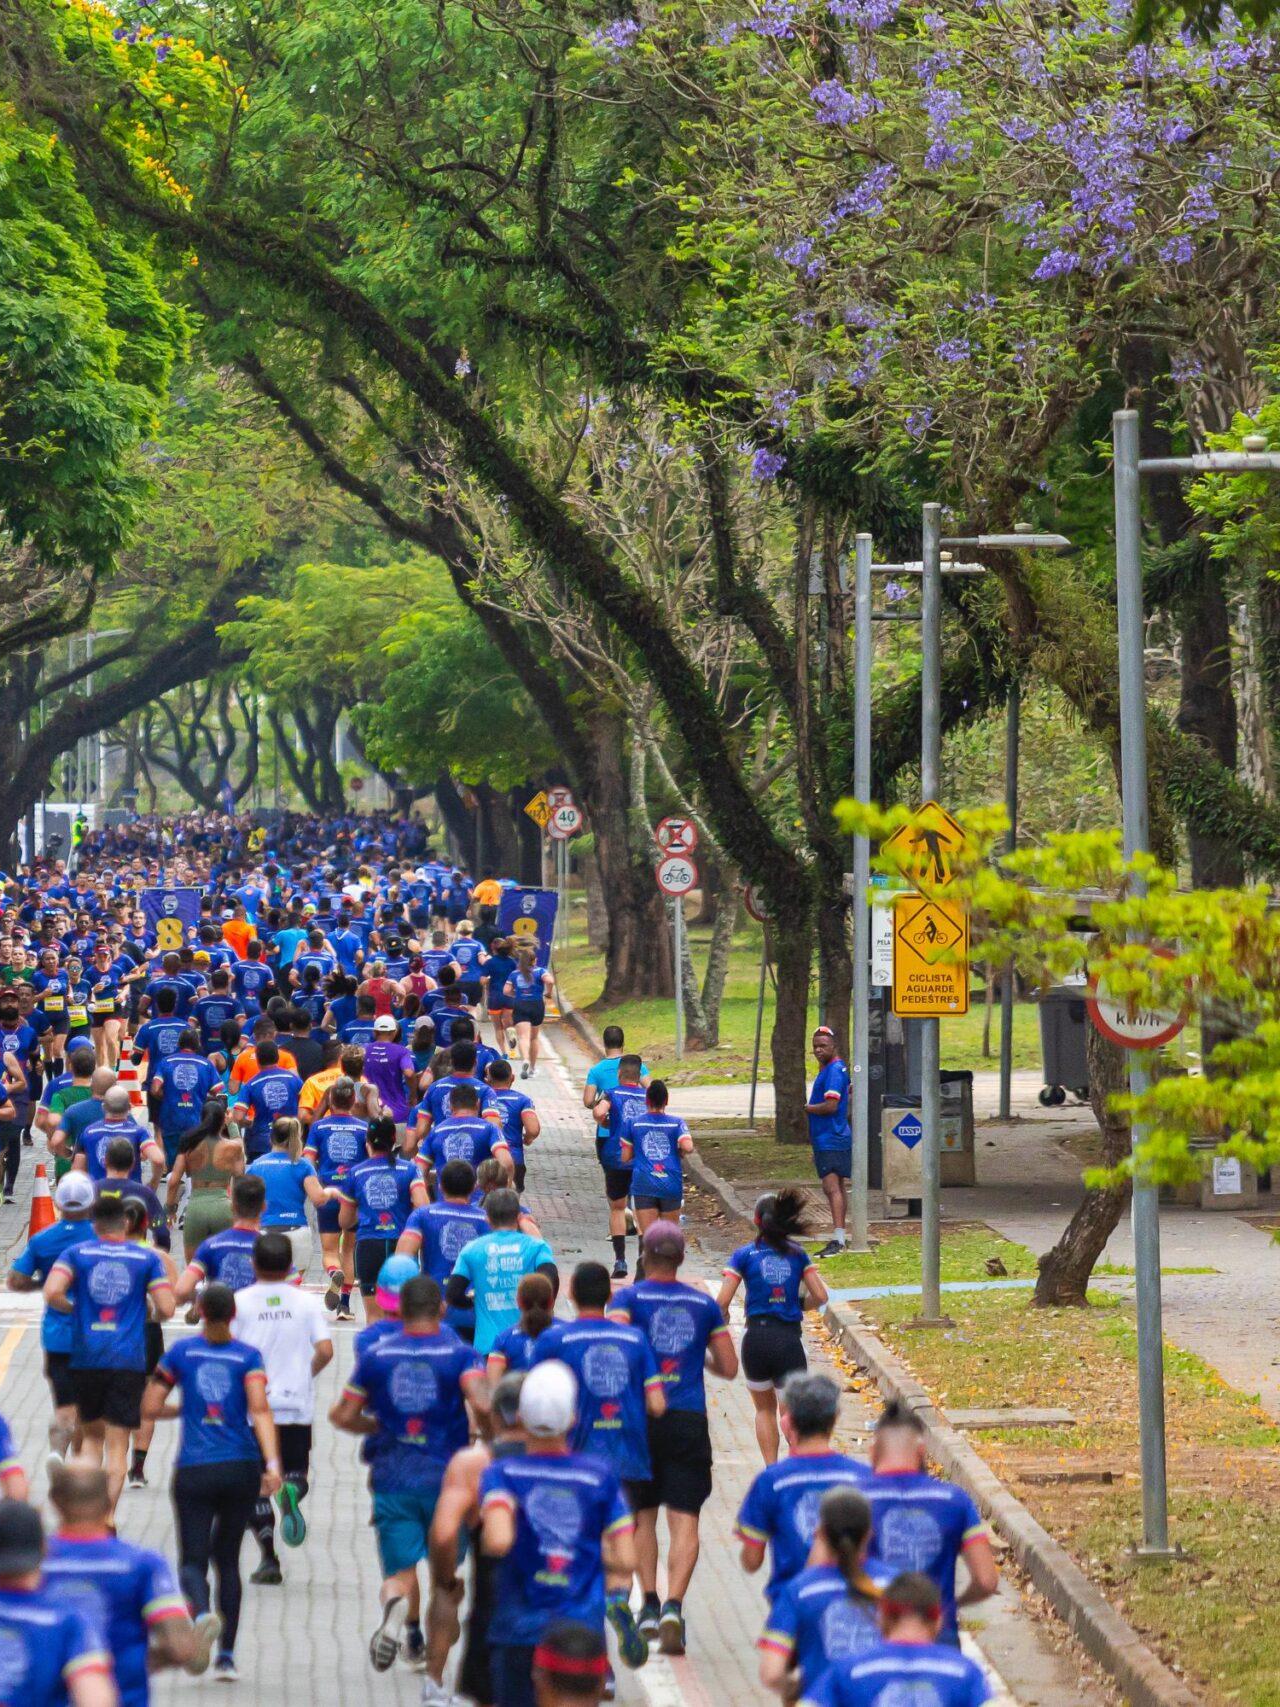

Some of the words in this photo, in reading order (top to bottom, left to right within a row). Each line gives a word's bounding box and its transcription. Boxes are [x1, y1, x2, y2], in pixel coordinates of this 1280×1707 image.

[558, 811, 575, 822] 40
[156, 918, 183, 950] 8
[909, 974, 952, 983] CICLISTA
[906, 985, 955, 993] AGUARDE
[901, 995, 960, 1004] PEDESTRES
[258, 1310, 292, 1321] ATLETA
